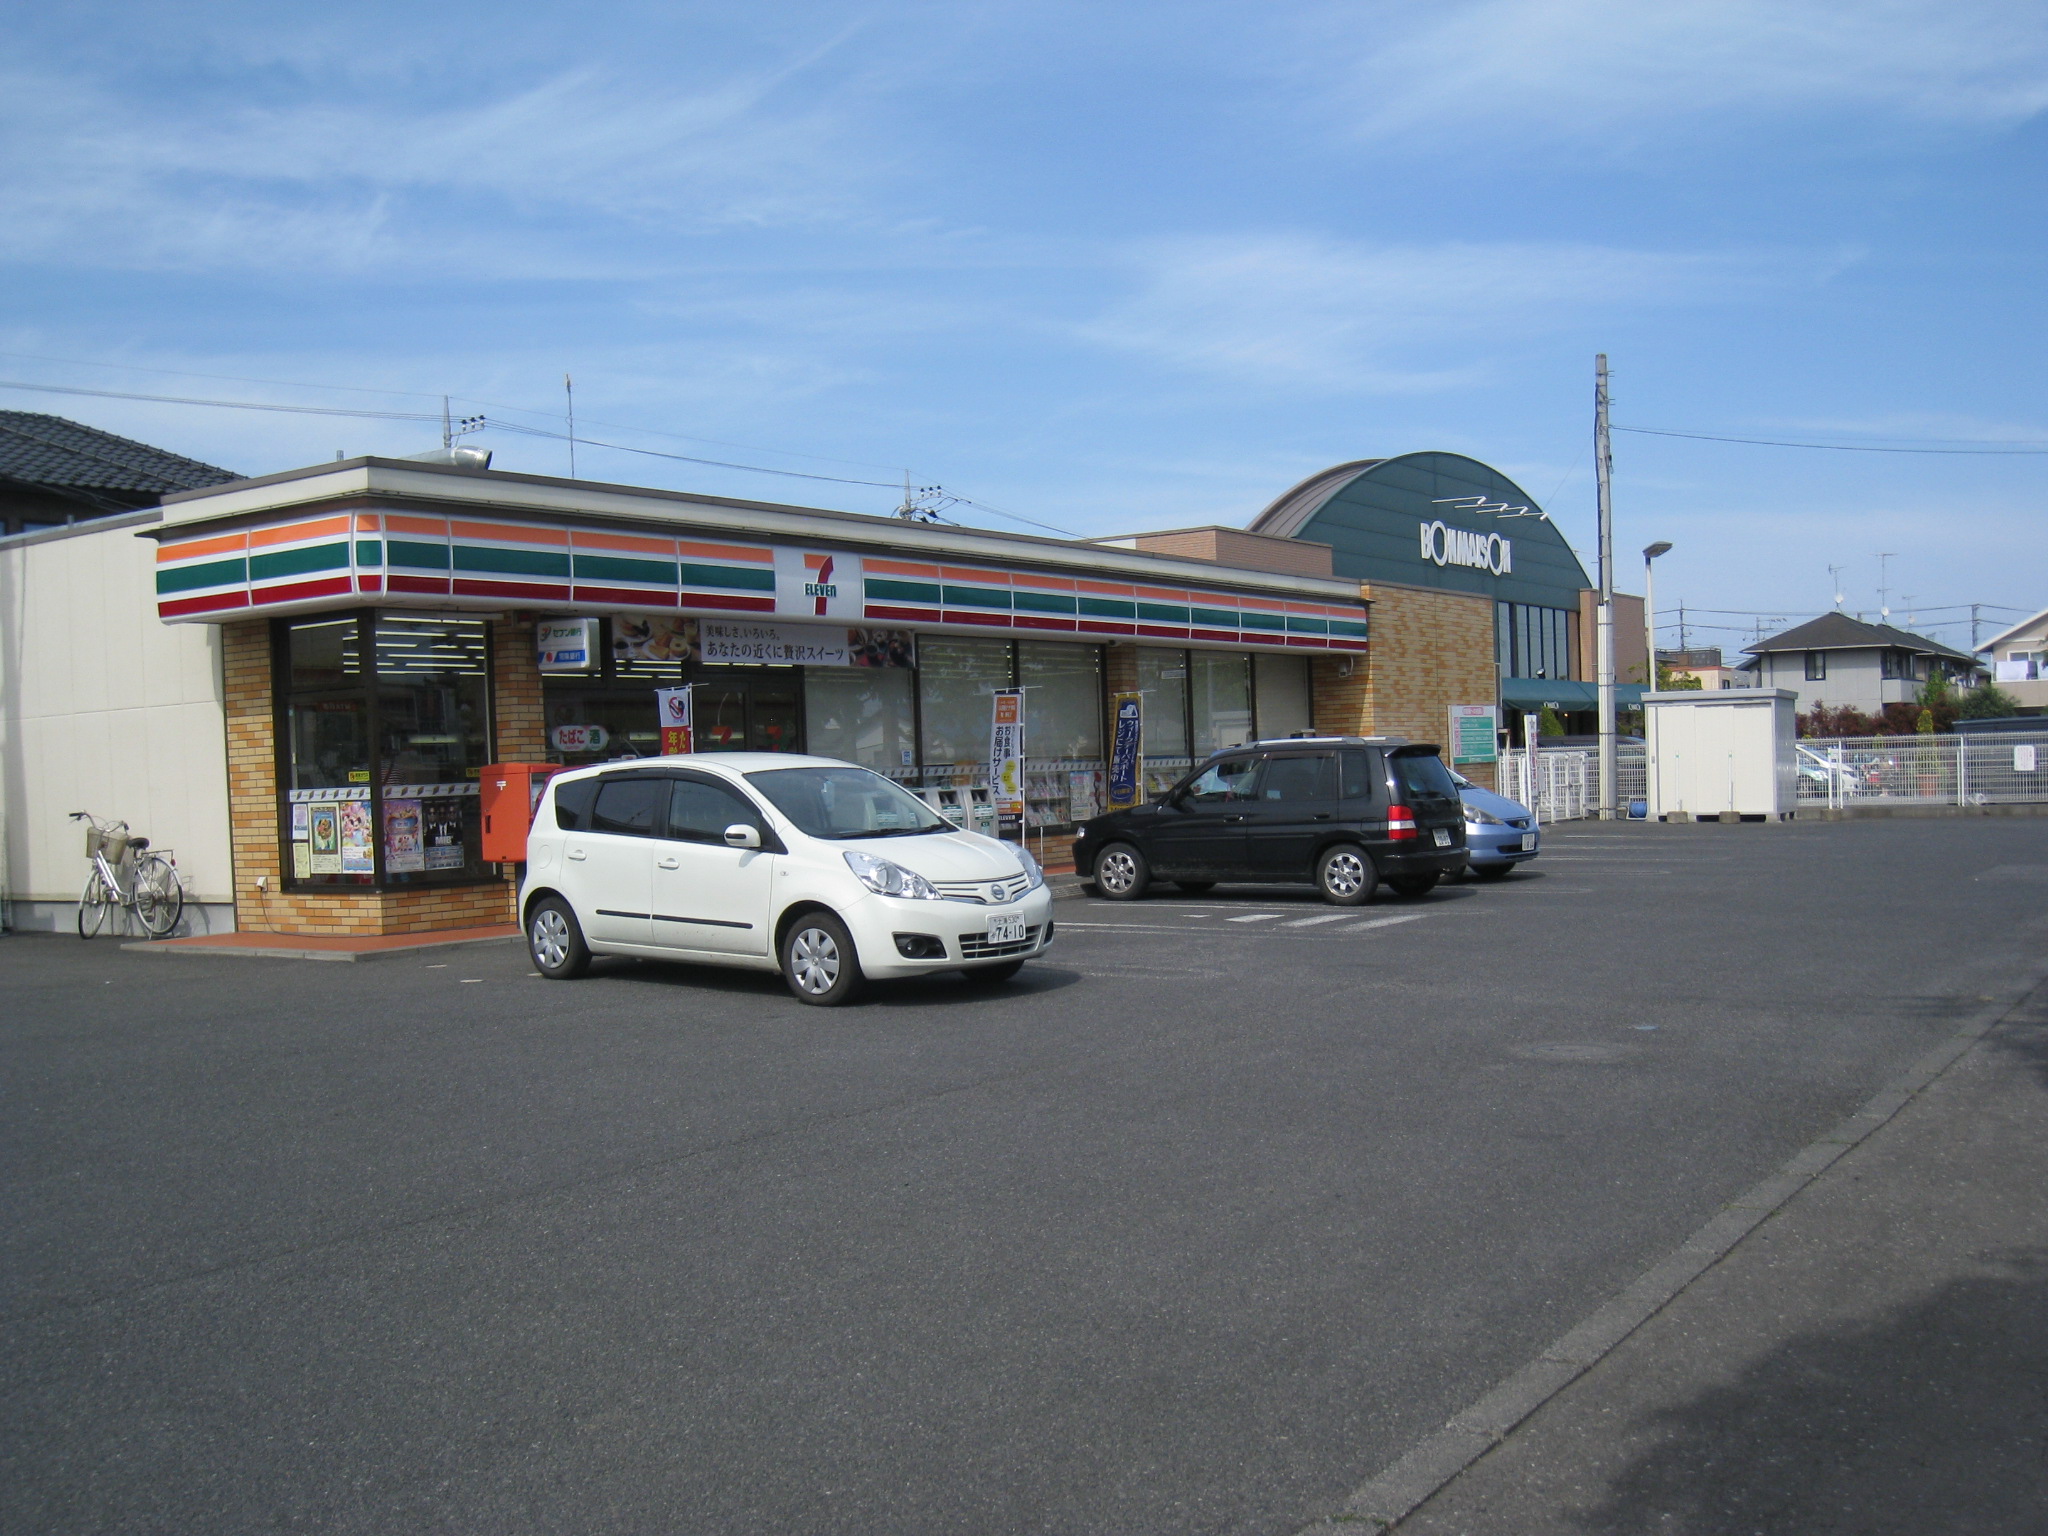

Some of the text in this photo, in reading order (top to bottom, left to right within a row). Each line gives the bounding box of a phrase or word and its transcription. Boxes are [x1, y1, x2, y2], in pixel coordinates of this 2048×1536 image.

[706, 625, 780, 641] 美味しさ、いろいろ。
[707, 641, 844, 661] あなたの近くに贅沢スイーツ
[559, 729, 585, 745] たばこ
[992, 726, 1003, 795] お届けサービス
[996, 925, 1024, 941] 74-10
